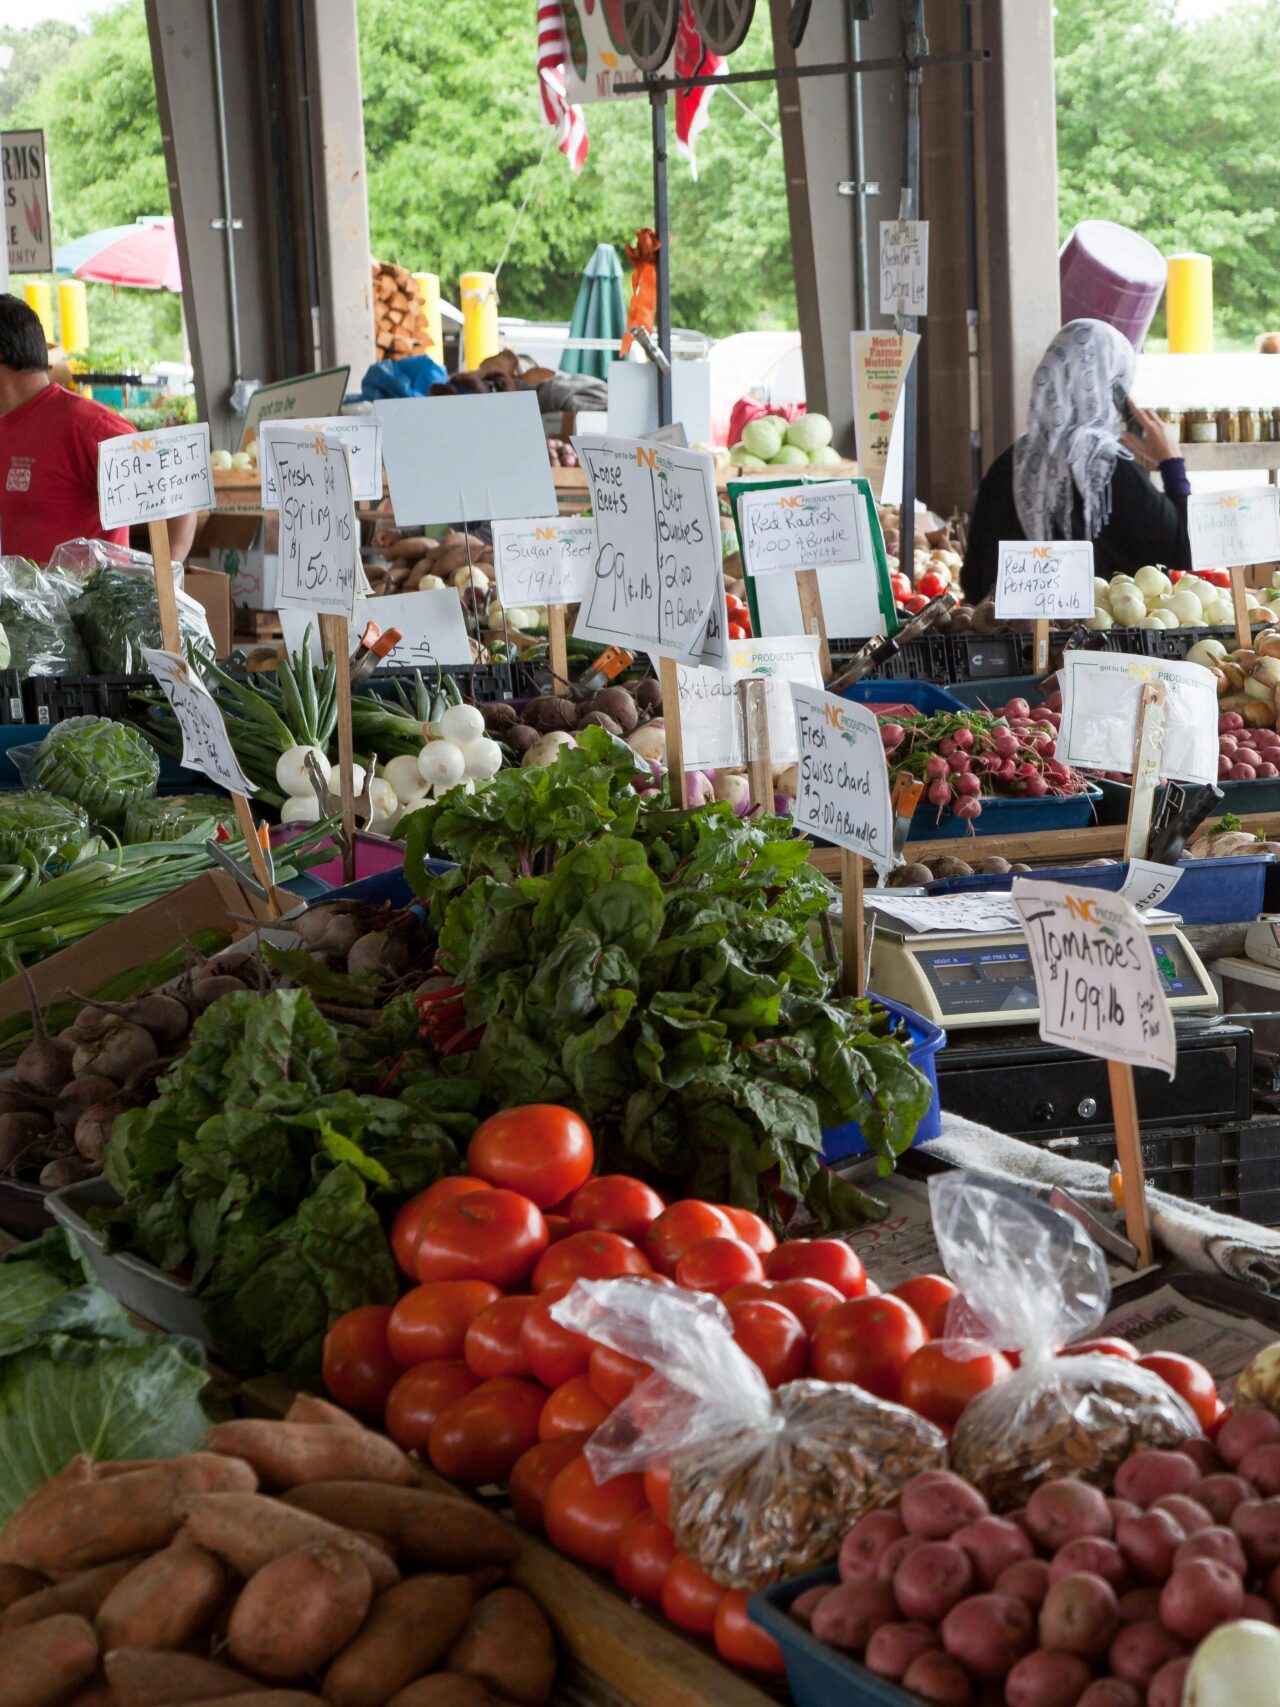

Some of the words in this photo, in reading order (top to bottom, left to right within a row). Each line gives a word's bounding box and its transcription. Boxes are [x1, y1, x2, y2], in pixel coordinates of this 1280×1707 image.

[1005, 556, 1026, 576] Red
[752, 652, 794, 662] PRODUCTS
[824, 703, 844, 731] NC
[802, 755, 834, 785] Swiss
[1066, 895, 1102, 924] NC
